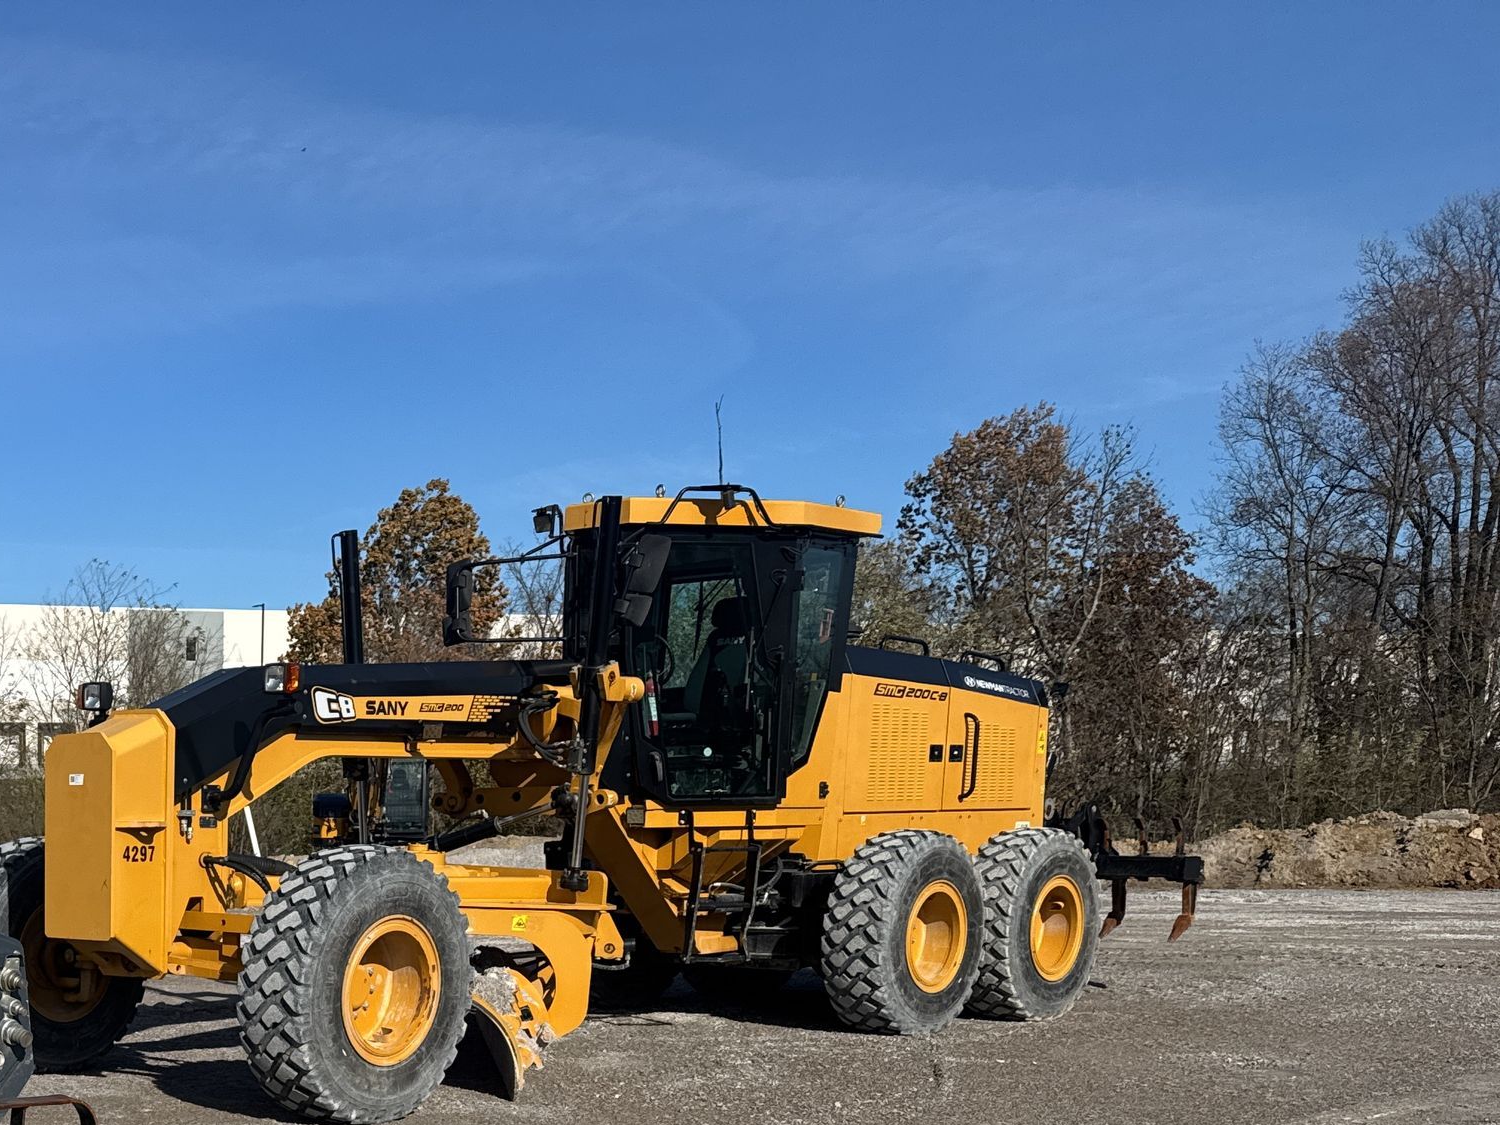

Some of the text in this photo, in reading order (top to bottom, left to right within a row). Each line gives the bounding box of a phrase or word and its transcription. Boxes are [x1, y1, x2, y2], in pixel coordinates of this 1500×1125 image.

[874, 683, 906, 698] SMG
[365, 700, 409, 716] SANY
[419, 703, 465, 712] SMG 200
[122, 845, 156, 863] 4297
